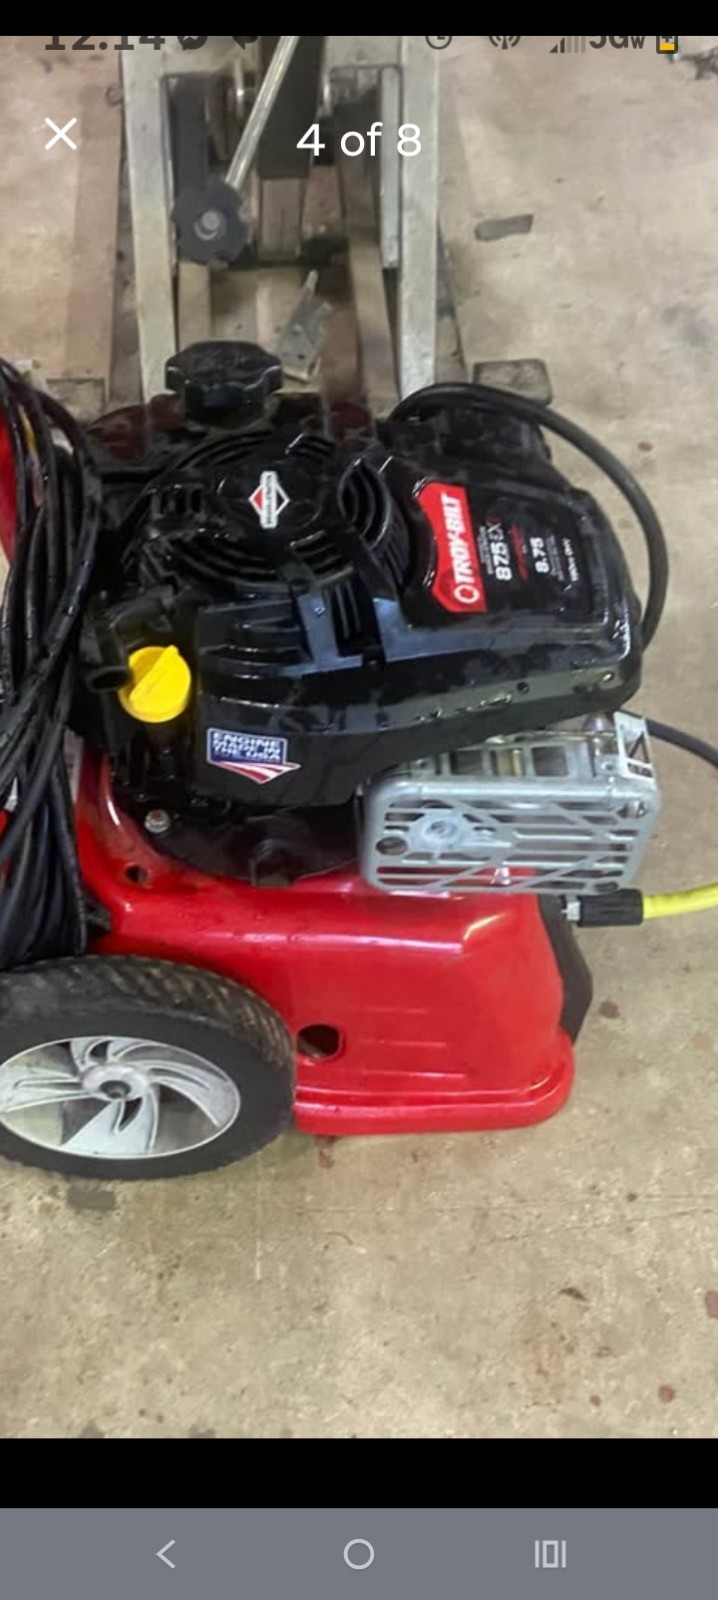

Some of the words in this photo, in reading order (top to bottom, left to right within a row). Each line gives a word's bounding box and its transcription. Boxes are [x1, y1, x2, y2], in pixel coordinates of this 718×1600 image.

[441, 491, 475, 584] TROY-BILT
[529, 537, 550, 573] 8.75
[212, 732, 281, 748] ENGINE
